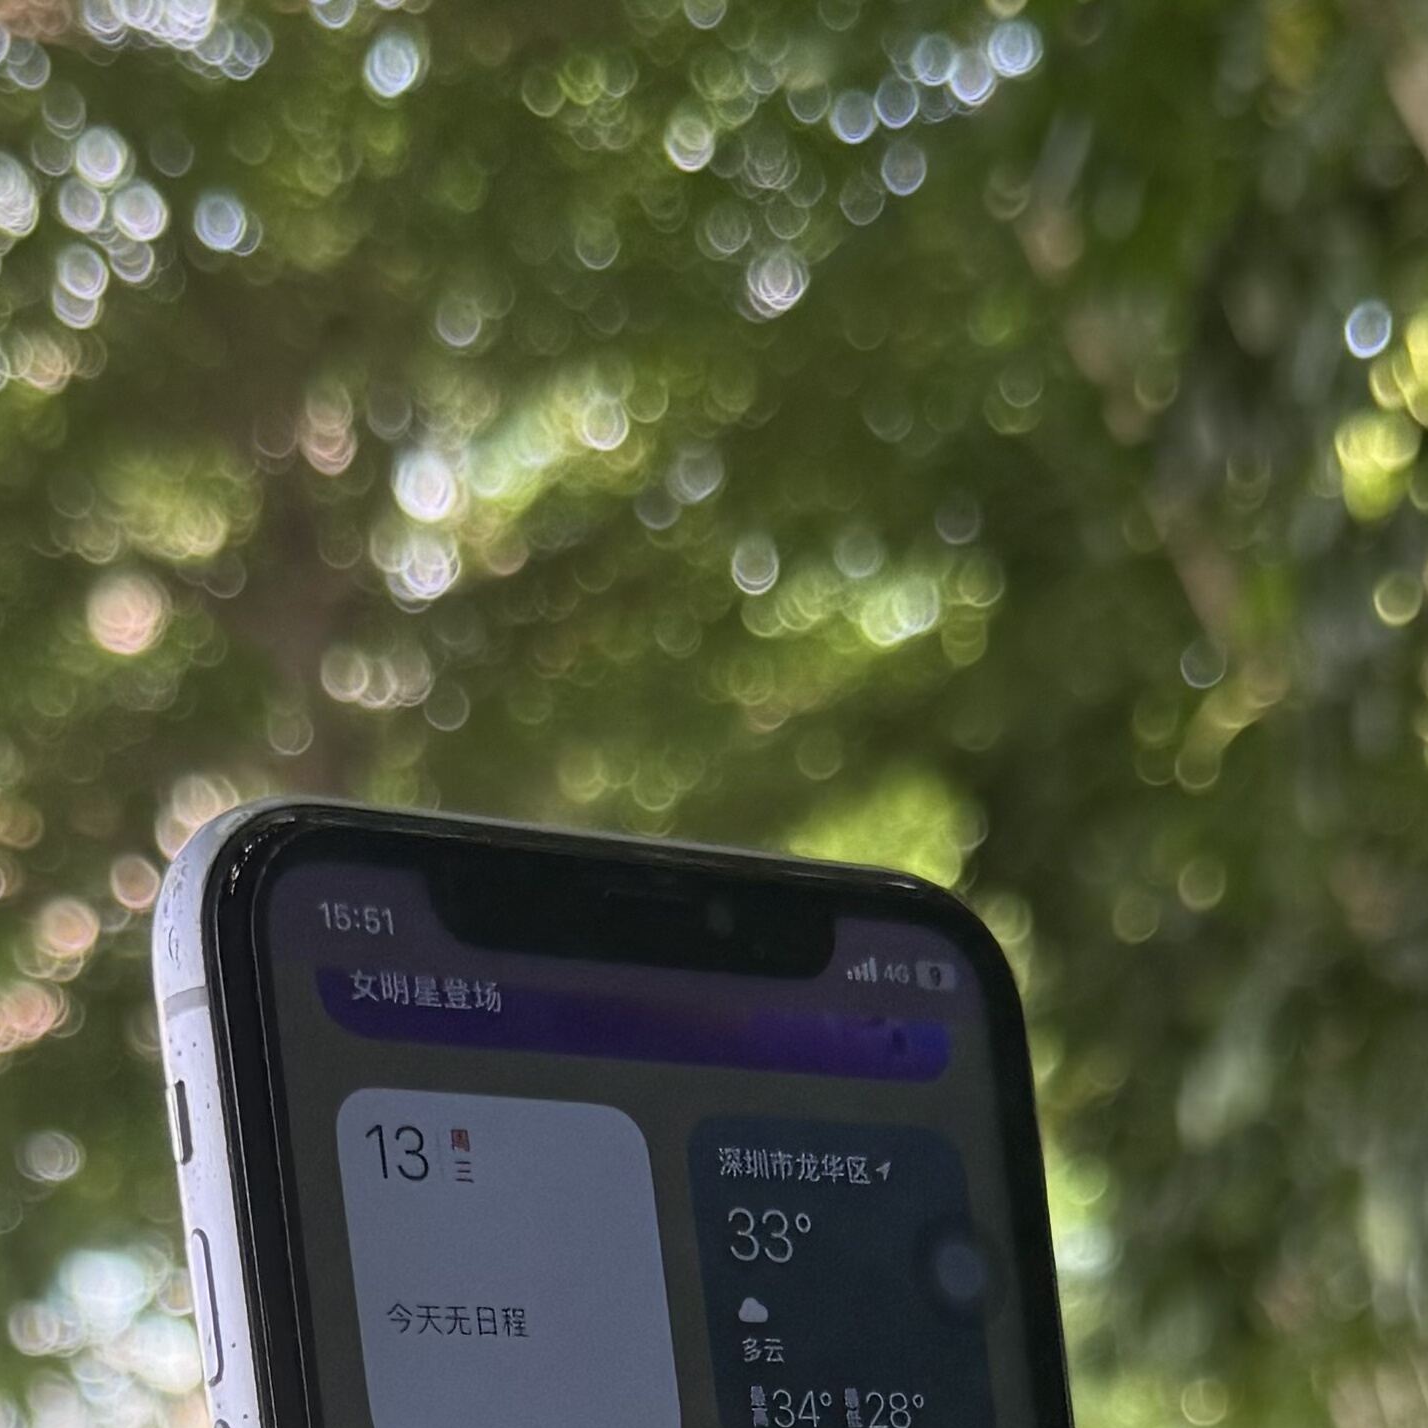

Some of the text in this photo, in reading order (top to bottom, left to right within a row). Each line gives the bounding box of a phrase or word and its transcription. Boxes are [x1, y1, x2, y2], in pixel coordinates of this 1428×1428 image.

[318, 902, 394, 936] 15:51
[349, 968, 502, 1014] 女明星登场
[365, 1124, 429, 1181] 13
[719, 1147, 871, 1185] 深圳市龙华区
[728, 1207, 811, 1263] 33°
[387, 1303, 529, 1338] 今天无日程
[742, 1337, 784, 1363] 多云
